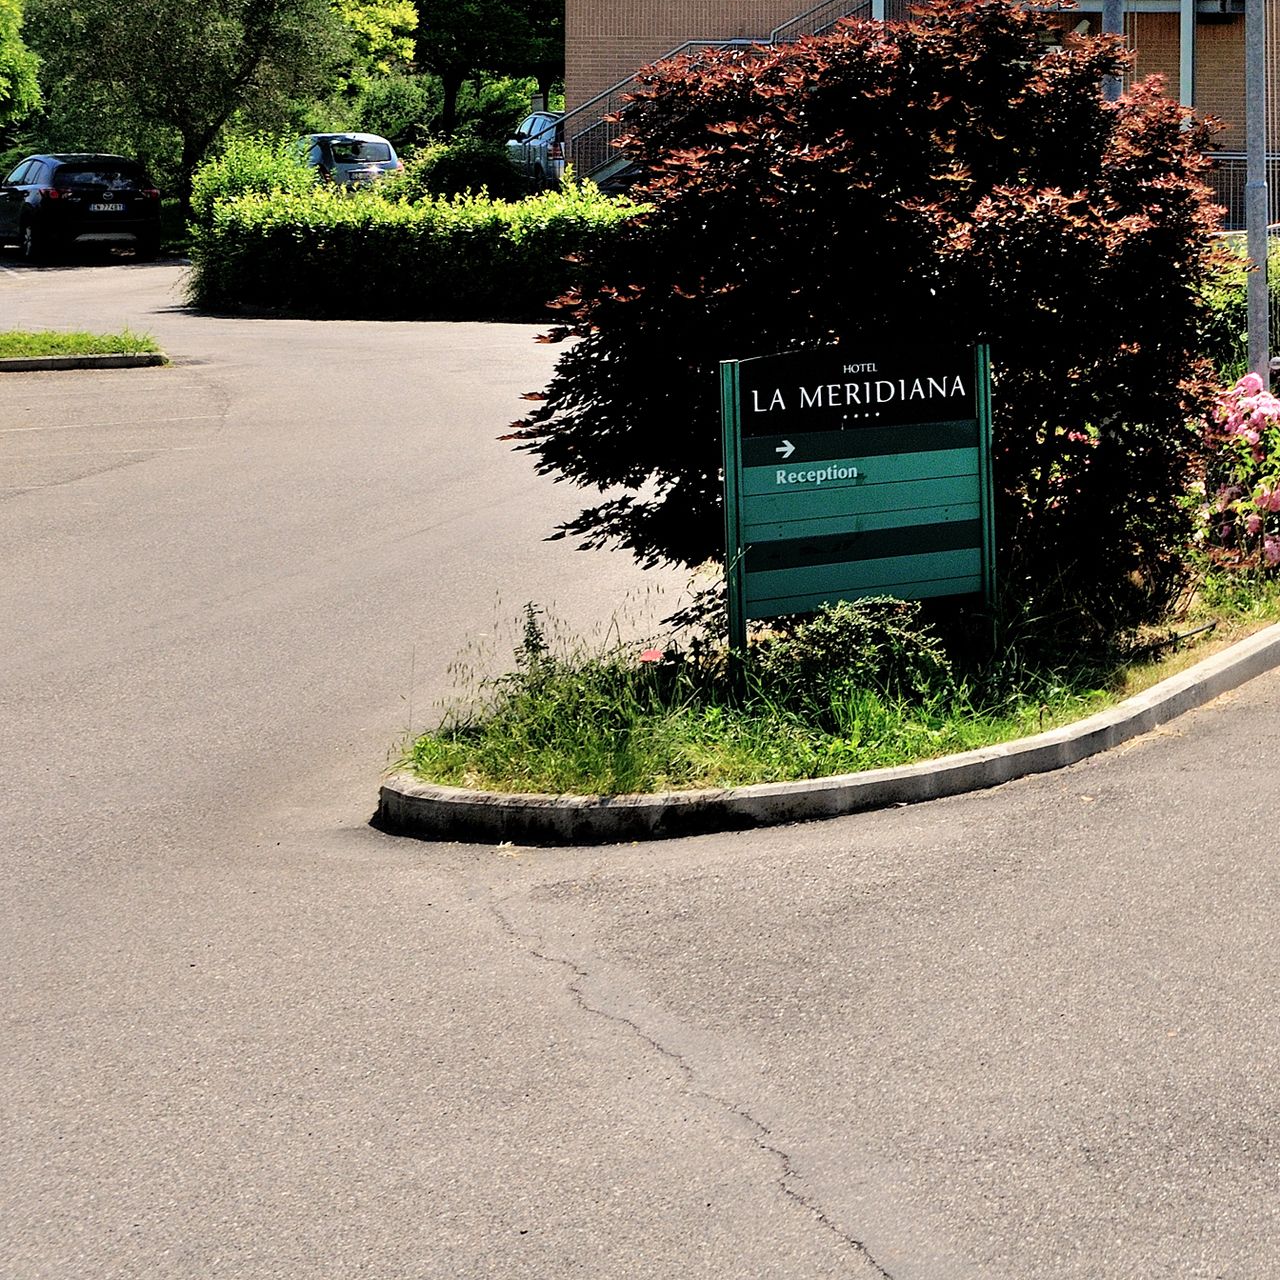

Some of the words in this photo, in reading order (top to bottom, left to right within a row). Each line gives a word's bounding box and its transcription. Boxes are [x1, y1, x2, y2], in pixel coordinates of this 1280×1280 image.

[842, 362, 878, 374] HOTEL
[751, 388, 787, 413] LA
[798, 374, 967, 410] MERIDIANA
[775, 464, 859, 486] Reception
